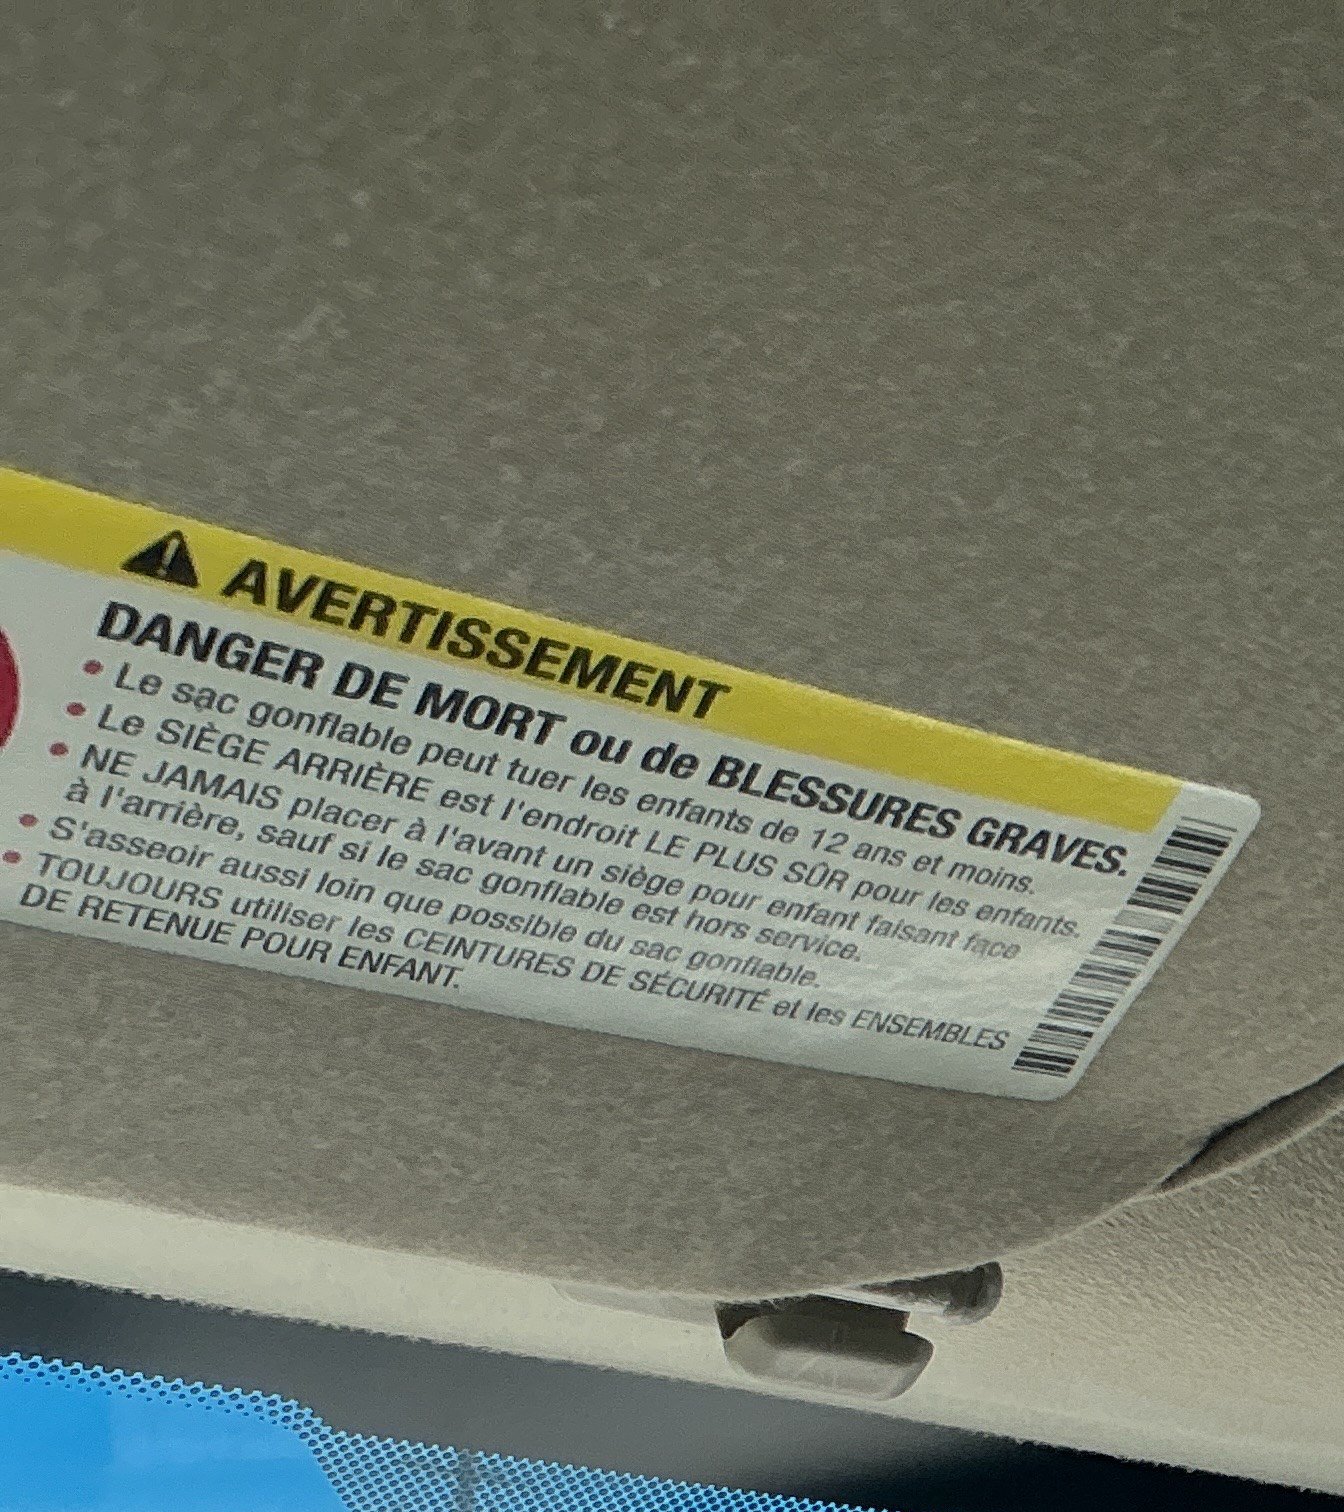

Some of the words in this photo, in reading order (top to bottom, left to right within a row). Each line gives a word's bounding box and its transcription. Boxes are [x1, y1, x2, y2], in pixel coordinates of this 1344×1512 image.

[220, 559, 732, 719] AVERTISSEMENT
[97, 601, 325, 690] DANGER
[332, 661, 410, 710] DE
[413, 682, 567, 745] MORT
[569, 729, 633, 764] ou
[640, 742, 700, 780] de
[707, 754, 962, 839] BLESSURES
[966, 817, 1127, 877] GRAVES.
[97, 703, 145, 737] Le
[155, 718, 270, 765] SIÈGE
[273, 747, 433, 802] ARRIÈRE
[439, 789, 495, 817] est
[500, 797, 640, 849] l'endroit
[644, 829, 691, 859] LE
[692, 841, 778, 877] PLUS
[782, 861, 850, 893] SÛR
[850, 879, 923, 907] pour
[926, 890, 970, 917] les
[974, 904, 1080, 939] enfants.
[114, 662, 163, 696] Le
[171, 682, 240, 715] sac
[246, 701, 412, 756] gonflable
[416, 742, 500, 777] peut
[506, 757, 575, 793] tuer
[579, 774, 630, 807] les
[636, 793, 754, 835] enfants
[759, 818, 800, 844] de
[811, 828, 850, 855] 12
[851, 842, 908, 867] ans
[912, 855, 944, 876] et
[946, 861, 1034, 895] moins.
[19, 882, 73, 913] DE
[77, 894, 237, 945] RETENUE
[240, 926, 333, 964] POUR
[337, 945, 464, 989] ENFANT.
[49, 816, 215, 869] S'asseoir
[218, 856, 311, 890] aussi
[314, 871, 376, 904] loin
[383, 890, 444, 917] que
[447, 903, 578, 943] possible
[583, 927, 625, 953] du
[628, 939, 683, 963] sac
[685, 950, 820, 989] gonflable.
[64, 776, 90, 805] à
[100, 784, 245, 842] l'arrière,
[256, 824, 337, 855] sauf
[338, 840, 372, 863] si
[376, 844, 408, 871] le
[415, 858, 474, 885] sac
[479, 872, 625, 915] gonflable
[631, 902, 680, 926] est
[683, 909, 751, 940] hors
[754, 927, 861, 962] service.
[80, 743, 136, 777] NE
[142, 760, 282, 810] JAMAIS
[287, 796, 399, 835] placer
[403, 816, 427, 843] à
[435, 823, 547, 868] l'avant
[552, 854, 594, 878] un
[600, 863, 685, 896] siège
[688, 883, 762, 911] pour
[766, 899, 861, 931] enfant
[864, 913, 960, 949] faisant
[962, 932, 1022, 960] face
[38, 852, 224, 910] TOUJOURS
[230, 896, 342, 933] utiliser
[347, 915, 395, 944] les
[403, 927, 576, 979] CEINTURES
[579, 960, 626, 987] DE
[628, 970, 771, 1012] SÉCURITÉ
[772, 998, 802, 1019] et
[804, 1001, 847, 1026] les
[850, 1009, 1010, 1051] ENSEMBLES
